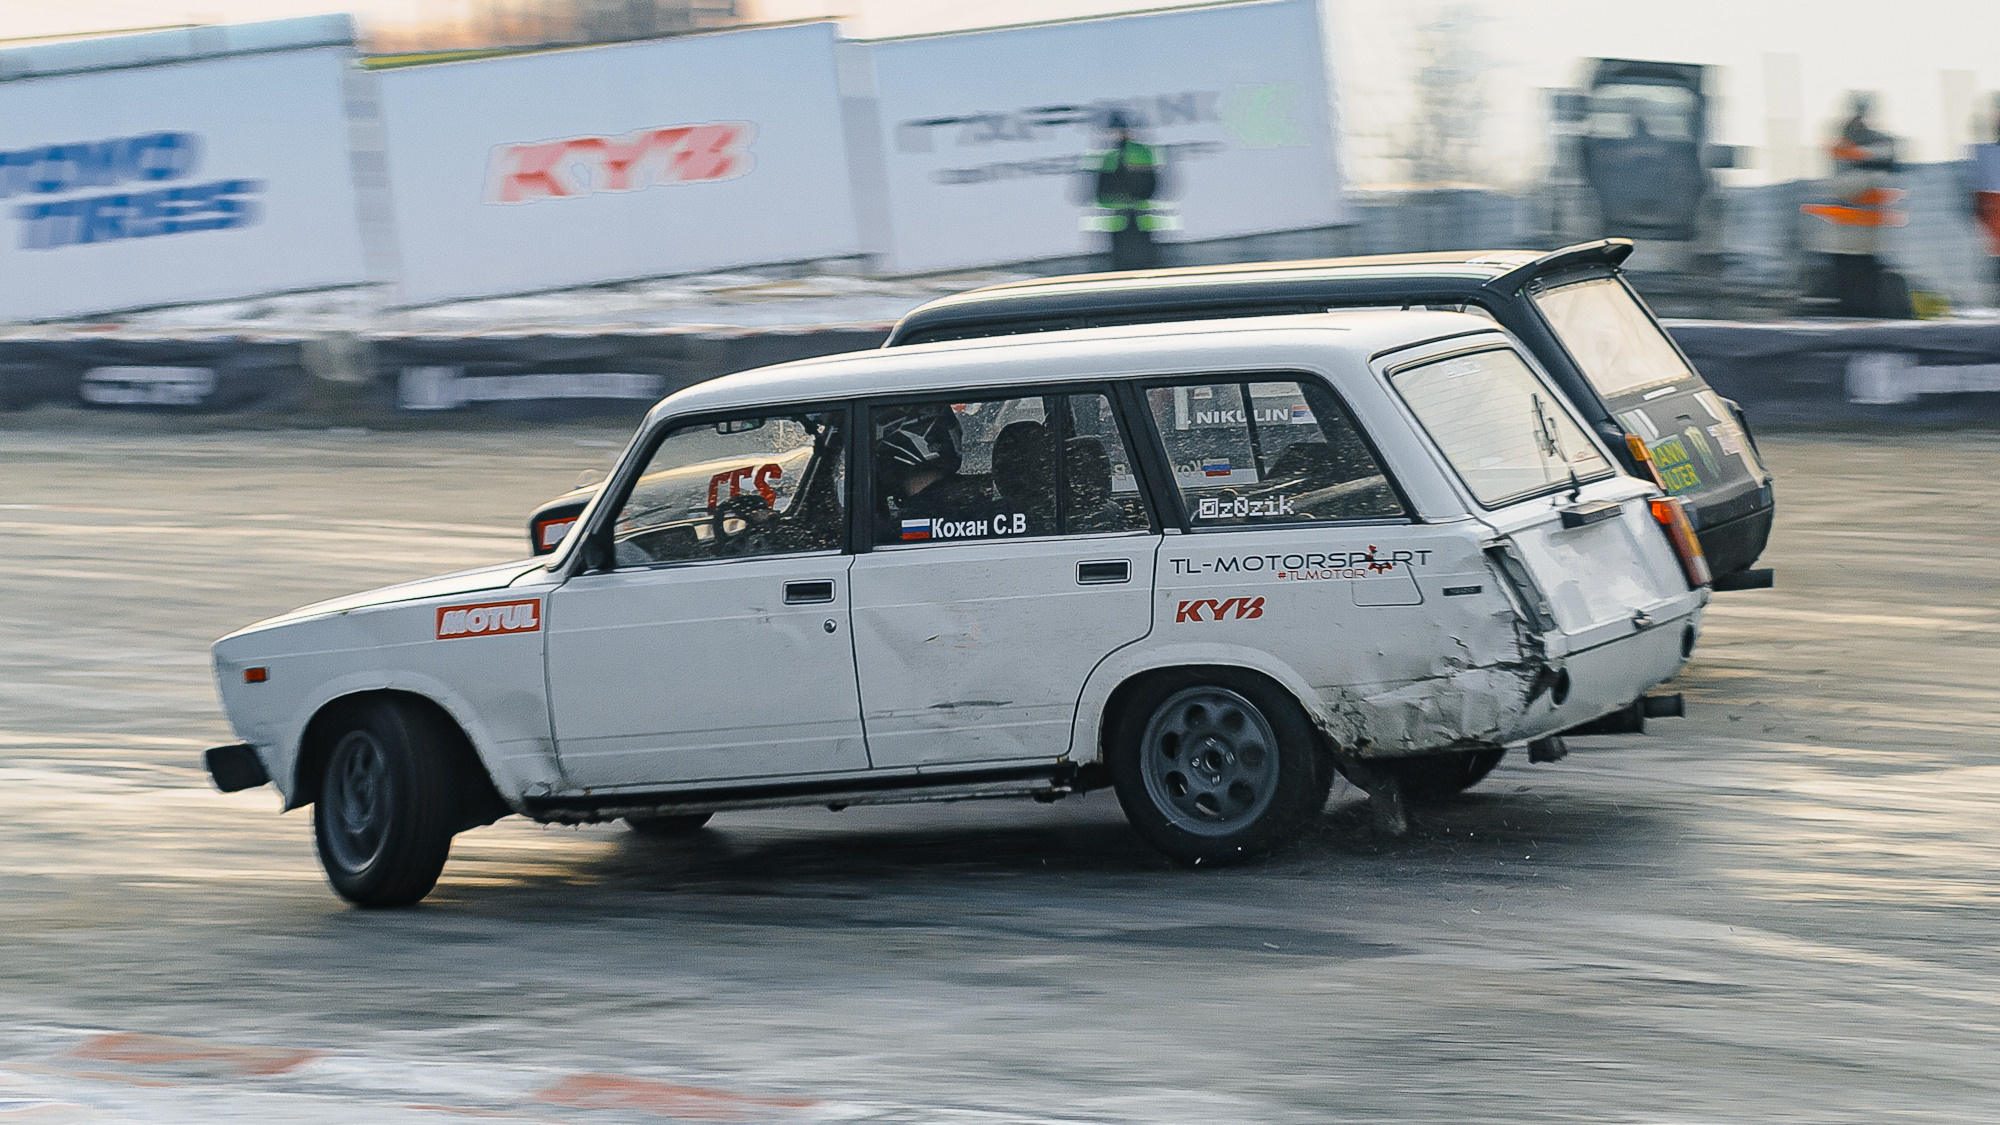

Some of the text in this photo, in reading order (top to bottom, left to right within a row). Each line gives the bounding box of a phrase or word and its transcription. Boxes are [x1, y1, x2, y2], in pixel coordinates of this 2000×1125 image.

[488, 124, 752, 203] KYB
[1196, 408, 1289, 424] NIKULIN
[932, 513, 1027, 538] Кохан С.В
[1277, 568, 1367, 581] #TLMOTOR
[439, 603, 538, 635] MOTUL
[1175, 596, 1266, 623] KYB
